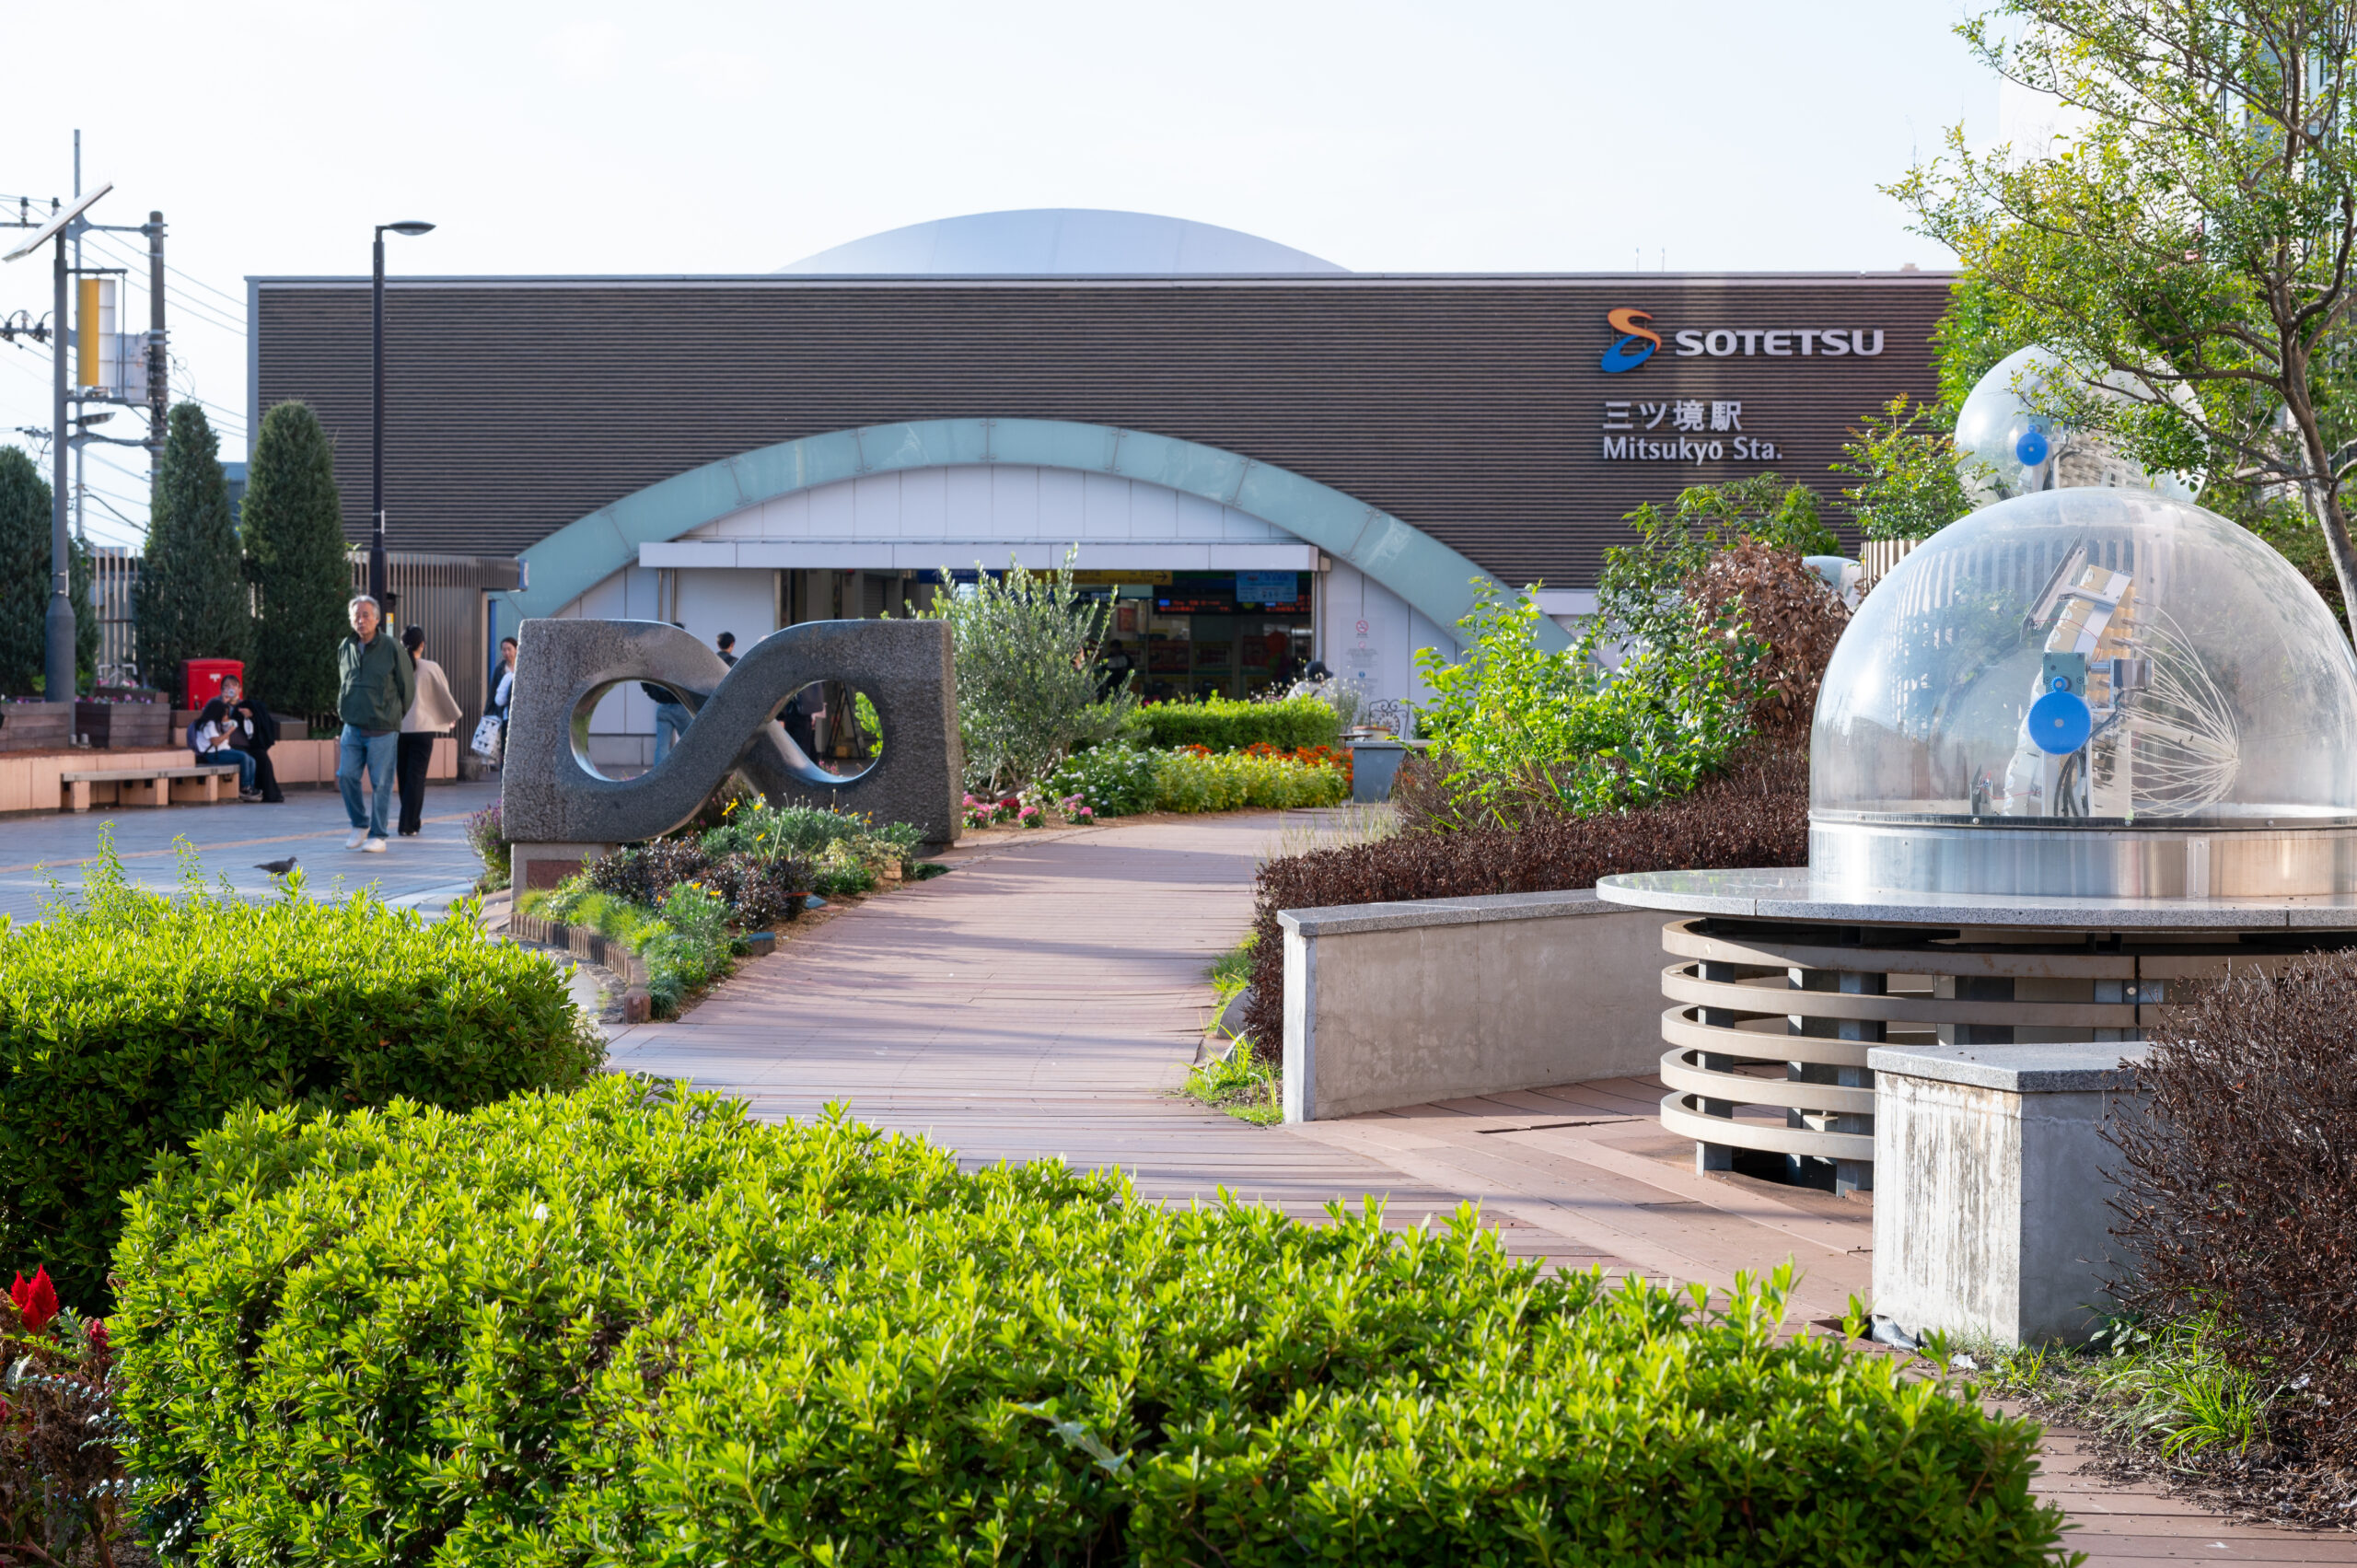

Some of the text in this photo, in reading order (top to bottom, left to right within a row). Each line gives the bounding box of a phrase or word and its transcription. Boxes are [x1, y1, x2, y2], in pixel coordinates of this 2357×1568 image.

[1675, 329, 1885, 356] SOTETSU
[1603, 400, 1742, 433] 三ツ境駅
[1733, 436, 1782, 459] Sta.
